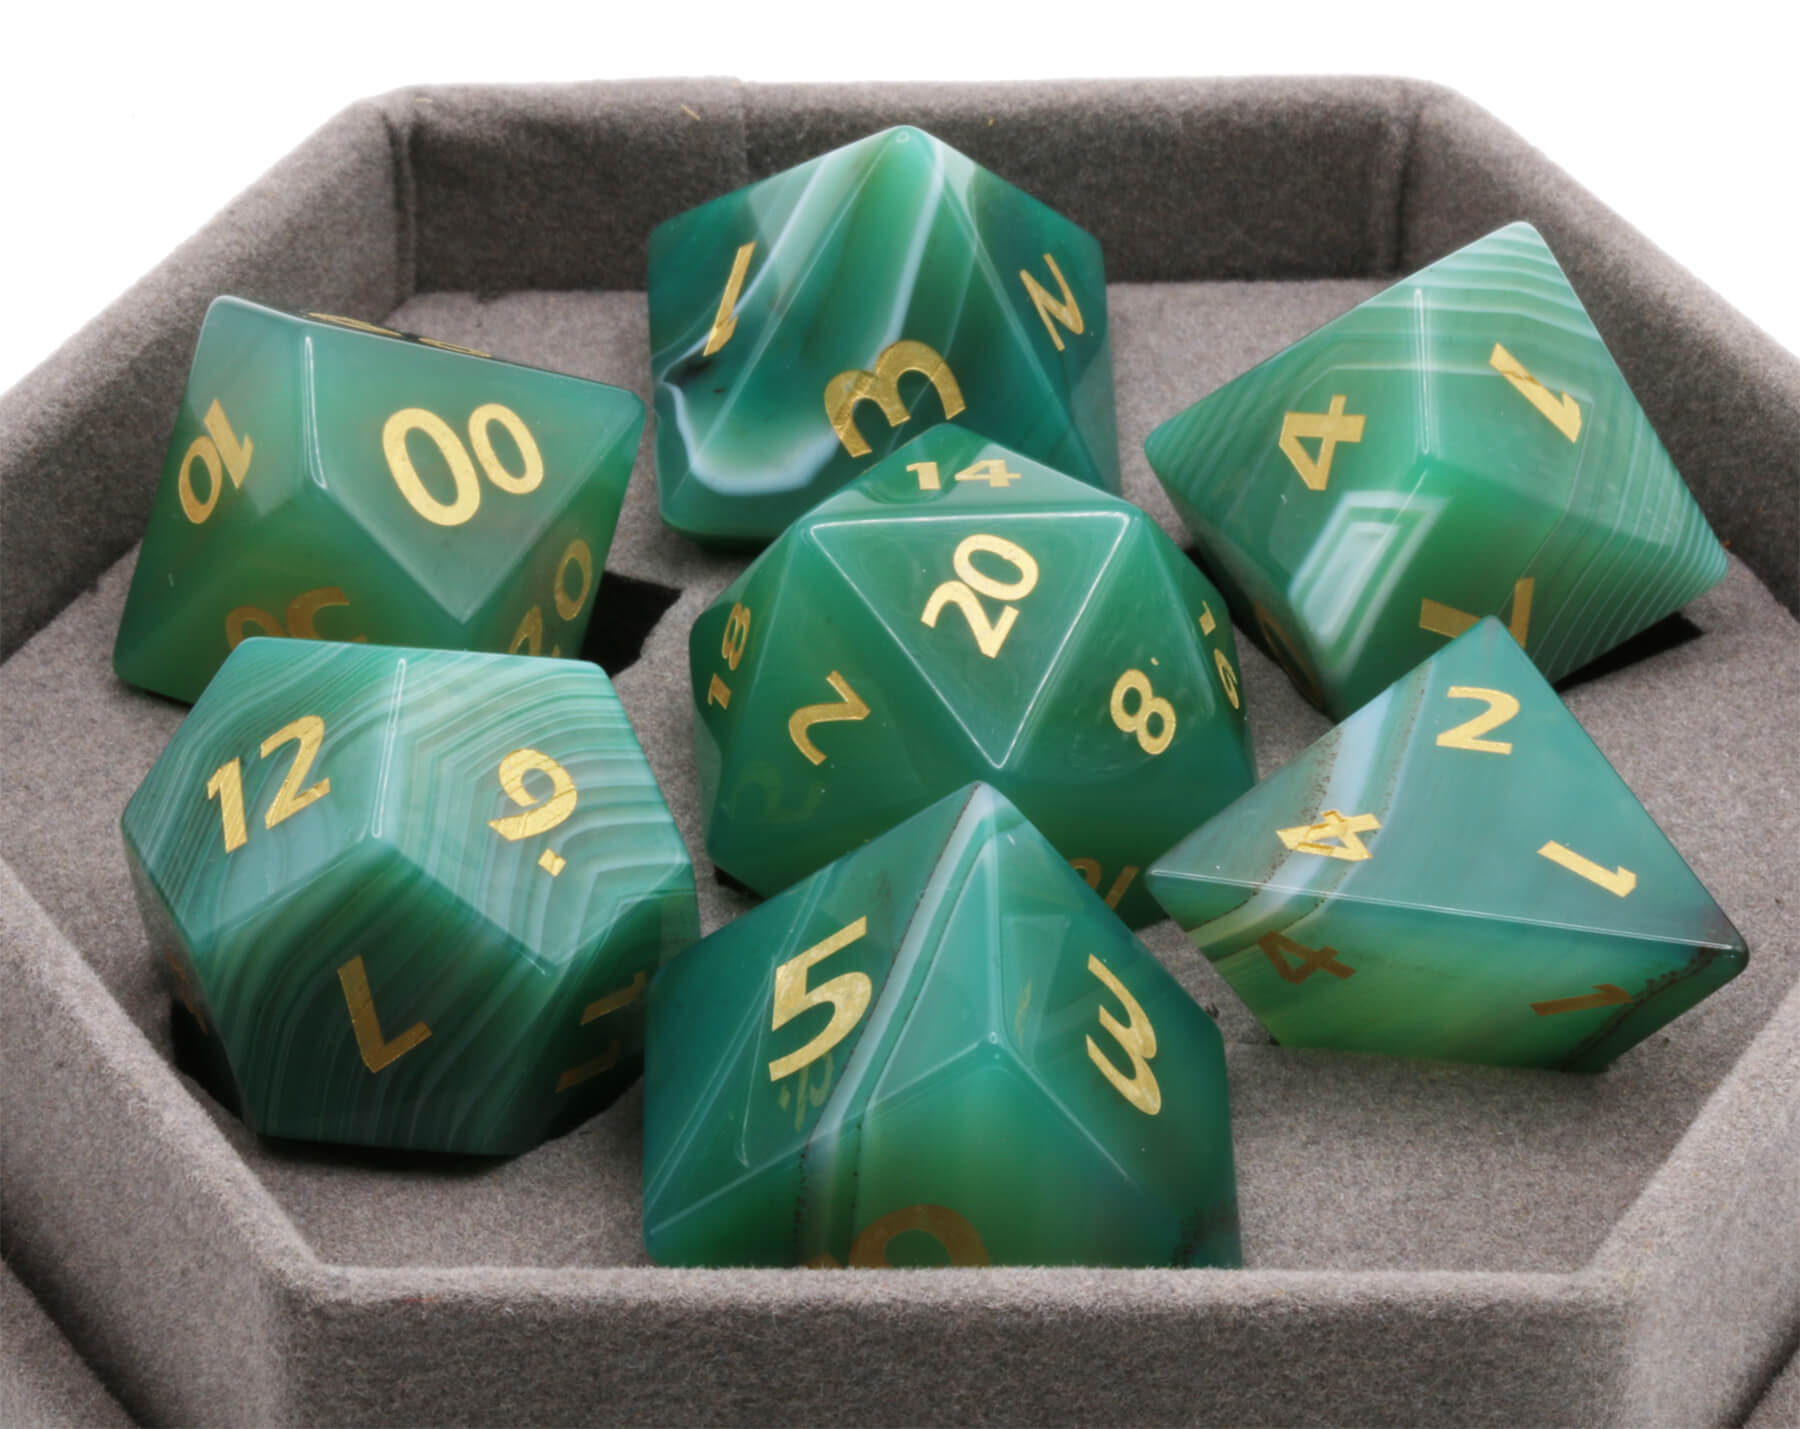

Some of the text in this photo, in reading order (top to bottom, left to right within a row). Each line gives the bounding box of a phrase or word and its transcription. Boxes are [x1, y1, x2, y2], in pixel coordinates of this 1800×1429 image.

[703, 241, 756, 357] 1
[823, 339, 966, 458] 3
[1279, 395, 1366, 491] 4
[1489, 342, 1582, 444] 1
[178, 398, 254, 524] 10
[382, 403, 544, 526] 00
[905, 459, 1022, 490] 14
[921, 533, 1039, 659] 20
[707, 601, 751, 710] 18
[1110, 668, 1177, 756] 8
[1436, 686, 1521, 755] 2
[206, 715, 331, 853] 12
[1276, 809, 1382, 862] 4
[1537, 840, 1638, 899] 1
[768, 916, 873, 1082] 5
[1257, 930, 1358, 985] 4
[337, 954, 433, 1074] 7
[1086, 953, 1162, 1116] 3
